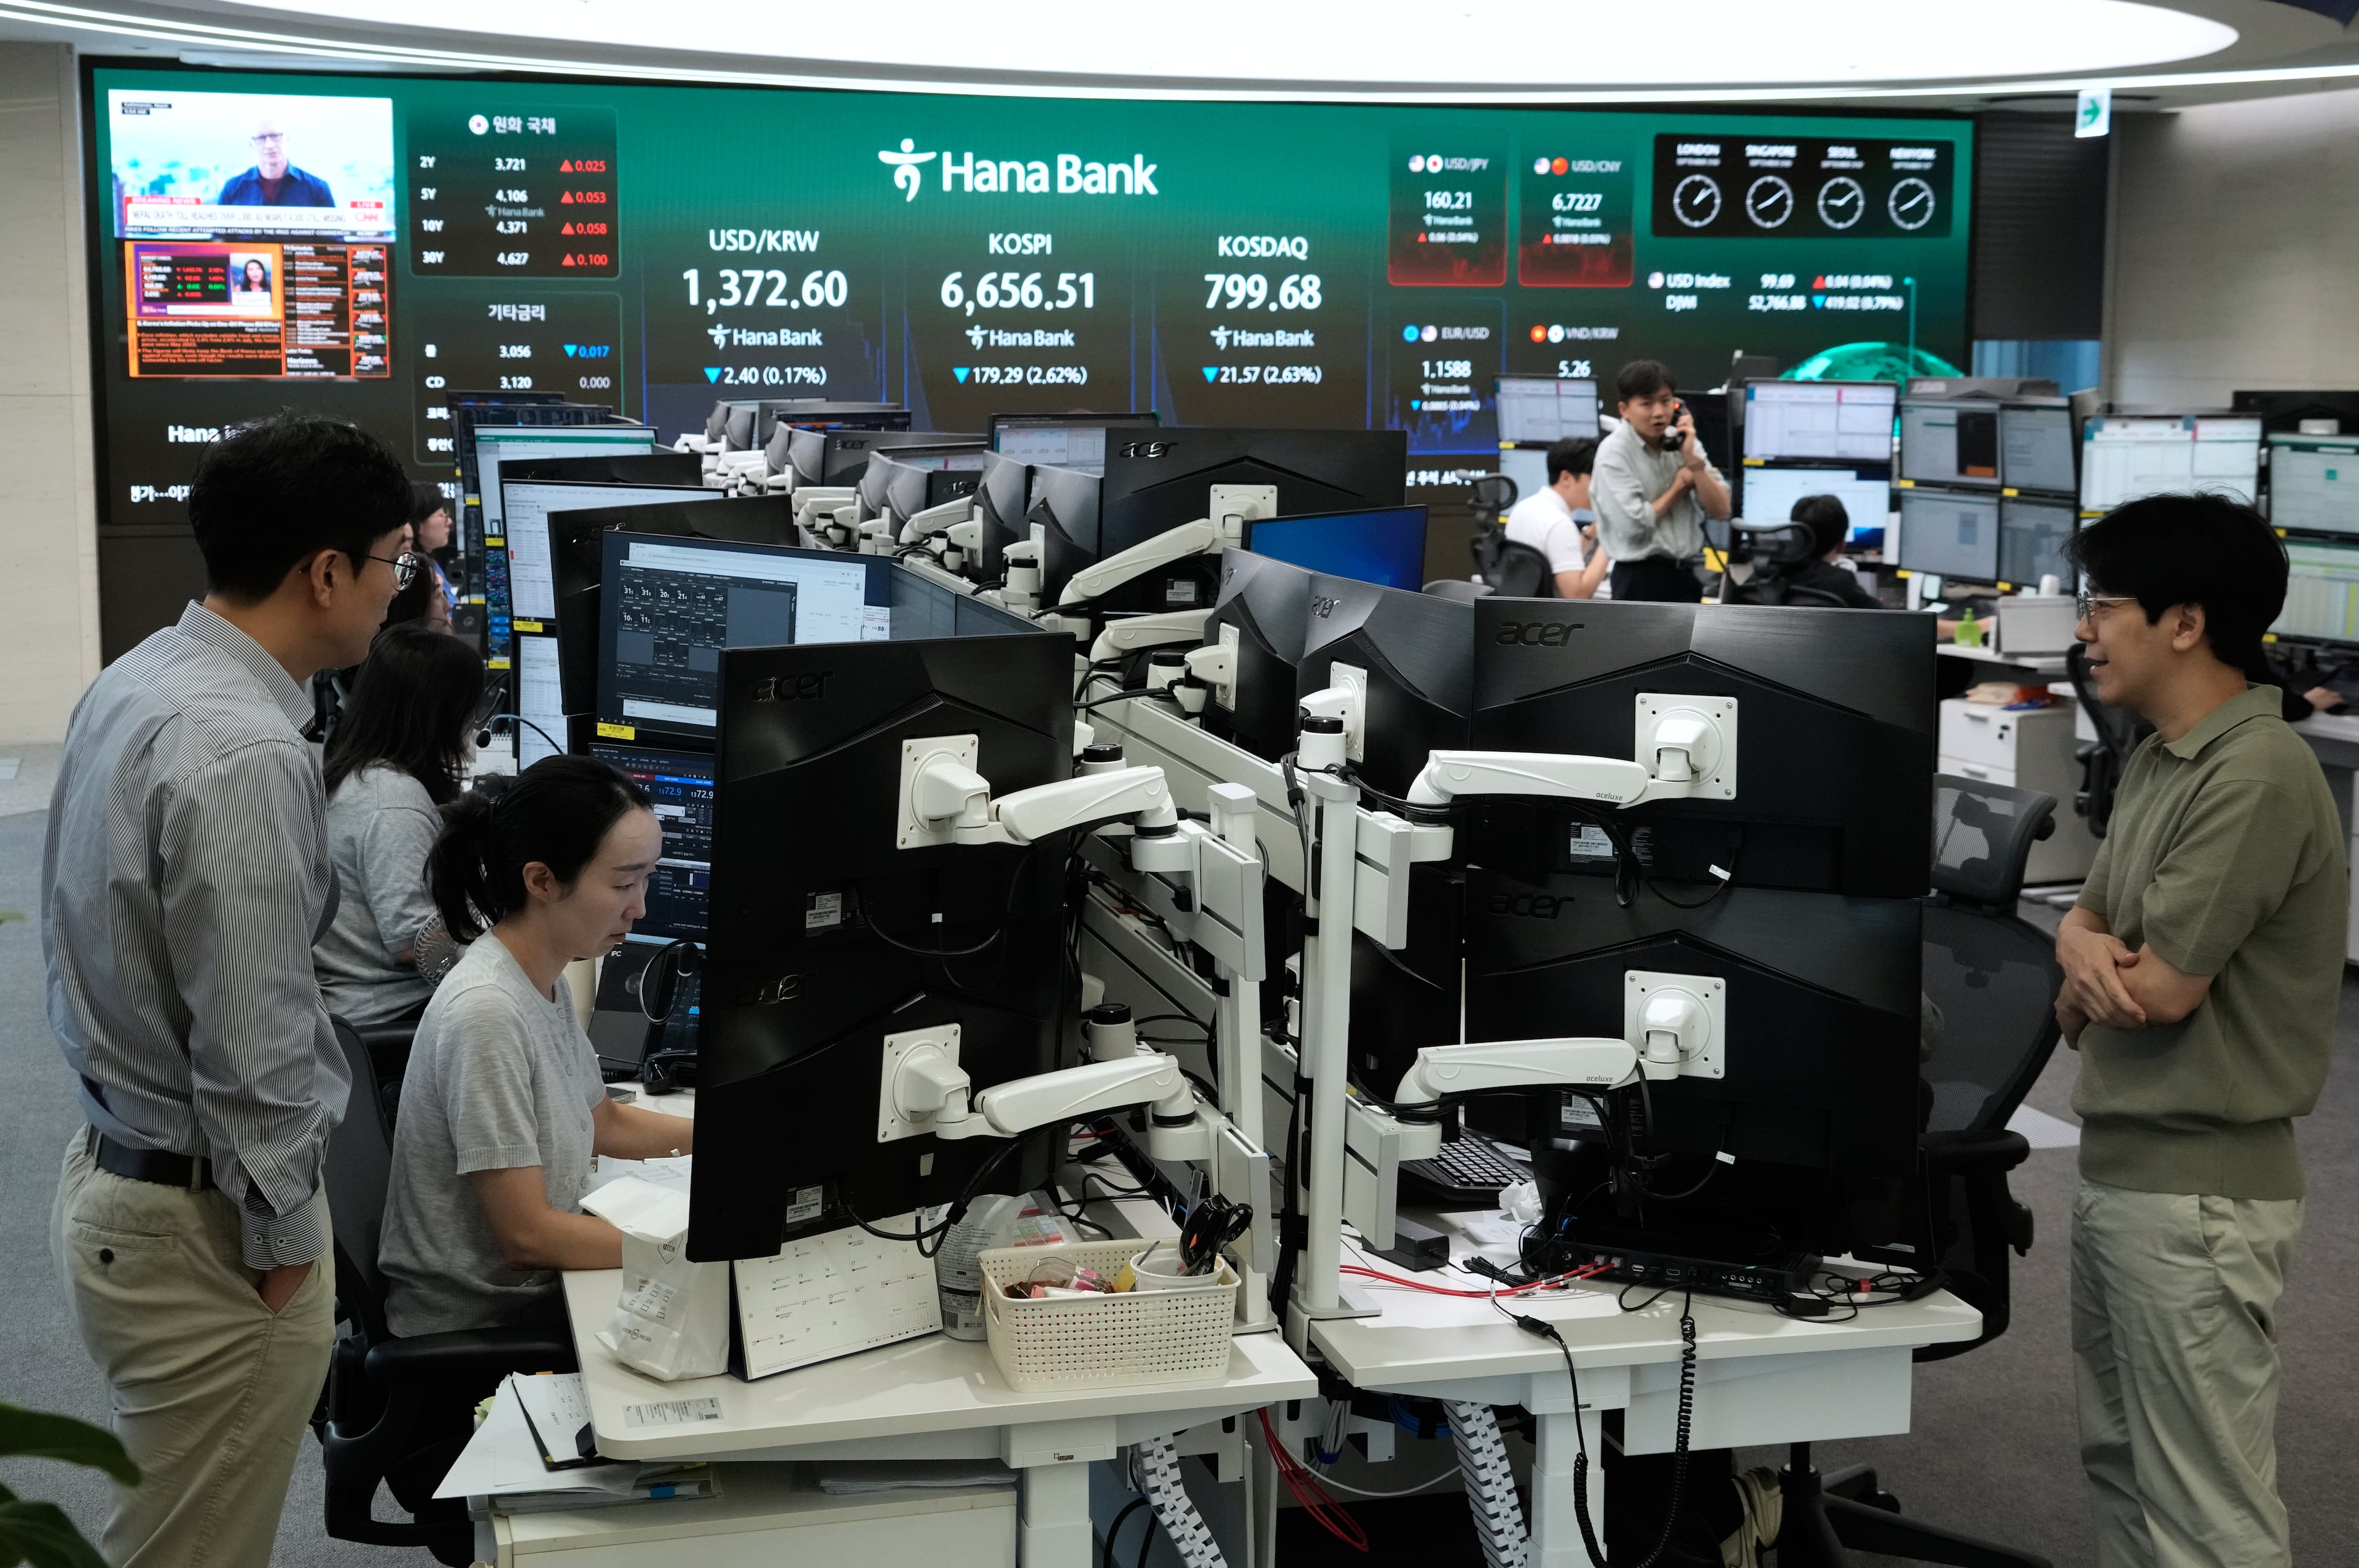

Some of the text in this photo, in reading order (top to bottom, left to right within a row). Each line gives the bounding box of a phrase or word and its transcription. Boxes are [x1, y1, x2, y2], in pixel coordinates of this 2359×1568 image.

[493, 116, 557, 135] 원화 국채
[1676, 144, 1720, 156] LONDON
[420, 156, 436, 168] 2Y
[495, 158, 526, 171] 3.721
[575, 160, 606, 172] 0.025
[1444, 158, 1489, 172] USD/JPY
[1571, 160, 1622, 173] USD/CNY
[942, 151, 1159, 195] Hana Bank
[421, 188, 437, 200] 5Y
[495, 190, 528, 203] 4.106
[576, 192, 606, 203] 0.053
[1424, 191, 1473, 209] 160.21
[1552, 193, 1602, 211] 6.7227
[355, 213, 378, 222] CNN
[498, 207, 545, 218] Hana Bank
[422, 220, 444, 232] 10Y
[496, 221, 527, 234] 4.371
[576, 223, 608, 235] 0.058
[709, 229, 820, 254] USD/KRW
[989, 233, 1052, 255] KOSPI
[1218, 236, 1308, 260] KOSDAQ
[422, 251, 445, 263] 30Y
[497, 252, 529, 265] 4.627
[577, 254, 608, 266] 0.100
[1666, 273, 1732, 289] USD Index
[683, 268, 848, 315] 1,372.60
[941, 271, 1093, 316] 6,656.51
[1204, 274, 1322, 312] 799.68
[488, 305, 546, 321] 기타금리
[733, 327, 823, 346] Hana Bank
[989, 329, 1075, 347] Hana Bank
[1232, 329, 1315, 347] Hana Bank
[1441, 326, 1490, 340] EUR/USD
[499, 345, 531, 358] 3.056
[578, 345, 610, 358] 0.017
[724, 366, 827, 386] 2.40 (0.17%)
[973, 366, 1088, 385] 179.29 (2.62%)
[1219, 365, 1322, 384] 21.57 (2.63%)
[1422, 361, 1472, 379] 1.1588
[1558, 360, 1590, 378] 5.26
[426, 376, 445, 388] CD
[500, 376, 533, 389] 3.120
[579, 376, 611, 389] 0.000
[168, 425, 221, 442] Hana
[1119, 442, 1178, 458] acer
[1495, 621, 1586, 647] acer
[751, 670, 834, 702] acer
[659, 786, 682, 796] 1372.9
[690, 789, 714, 799] 1372.9
[1596, 792, 1623, 801] aceluxe
[1485, 892, 1575, 920] acer
